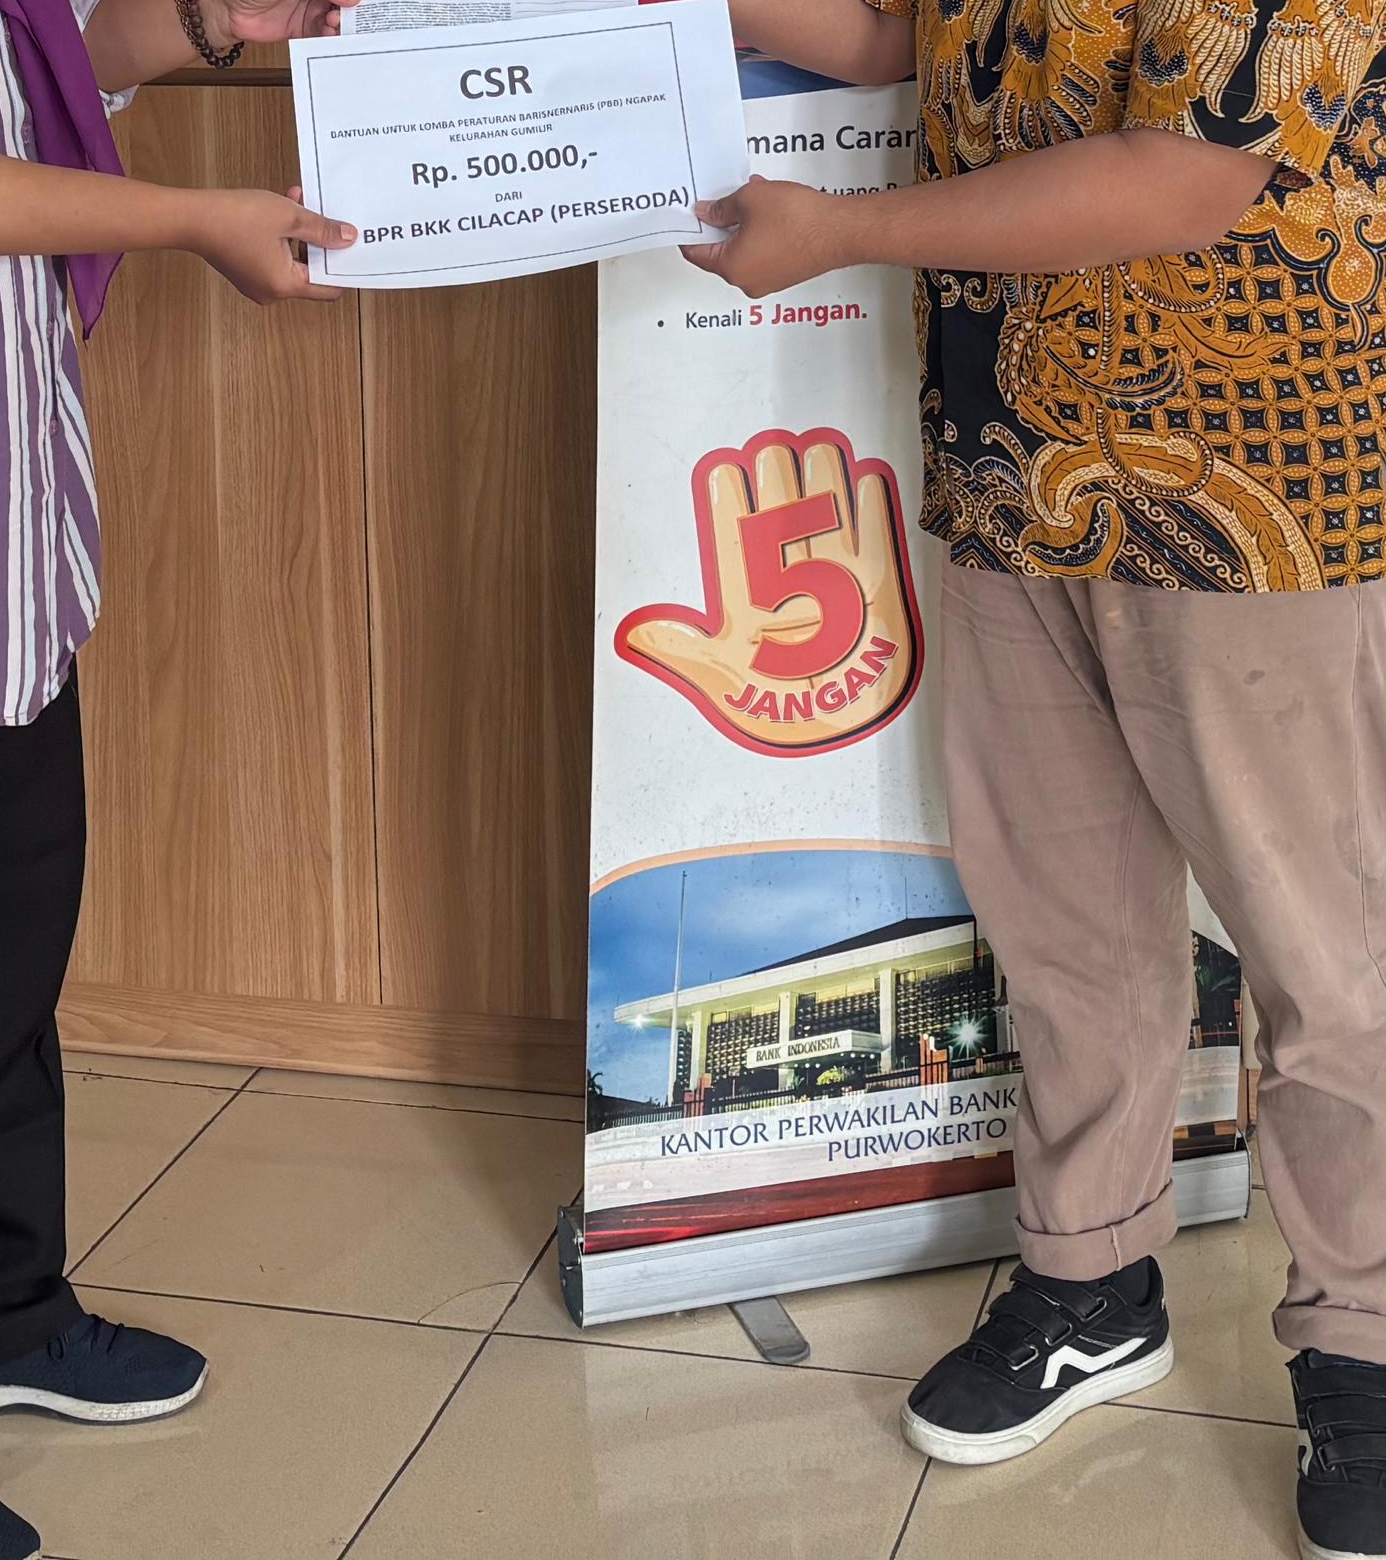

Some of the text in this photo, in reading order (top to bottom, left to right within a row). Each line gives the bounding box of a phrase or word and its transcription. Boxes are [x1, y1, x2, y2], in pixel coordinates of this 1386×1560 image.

[460, 65, 533, 100] CSR
[382, 123, 417, 135] UNTUK
[419, 119, 455, 132] LOMBA
[457, 114, 517, 128] PERATURAN
[625, 93, 667, 106] NGAPAK
[449, 128, 509, 142] KELURAHAN
[411, 144, 598, 188] Rp. 500.000,-
[363, 186, 690, 244] BPR BKK CILACAP (PERSERODA)
[494, 191, 523, 203] DARI
[685, 302, 868, 333] Kenali 5 Jangan.
[737, 490, 866, 681] 5
[723, 635, 899, 723] JANGAN
[756, 1047, 781, 1062] BANK
[661, 1087, 1018, 1157] KANTOR PERWAKILAN BANK
[828, 1117, 1008, 1162] PURWOKERTO
